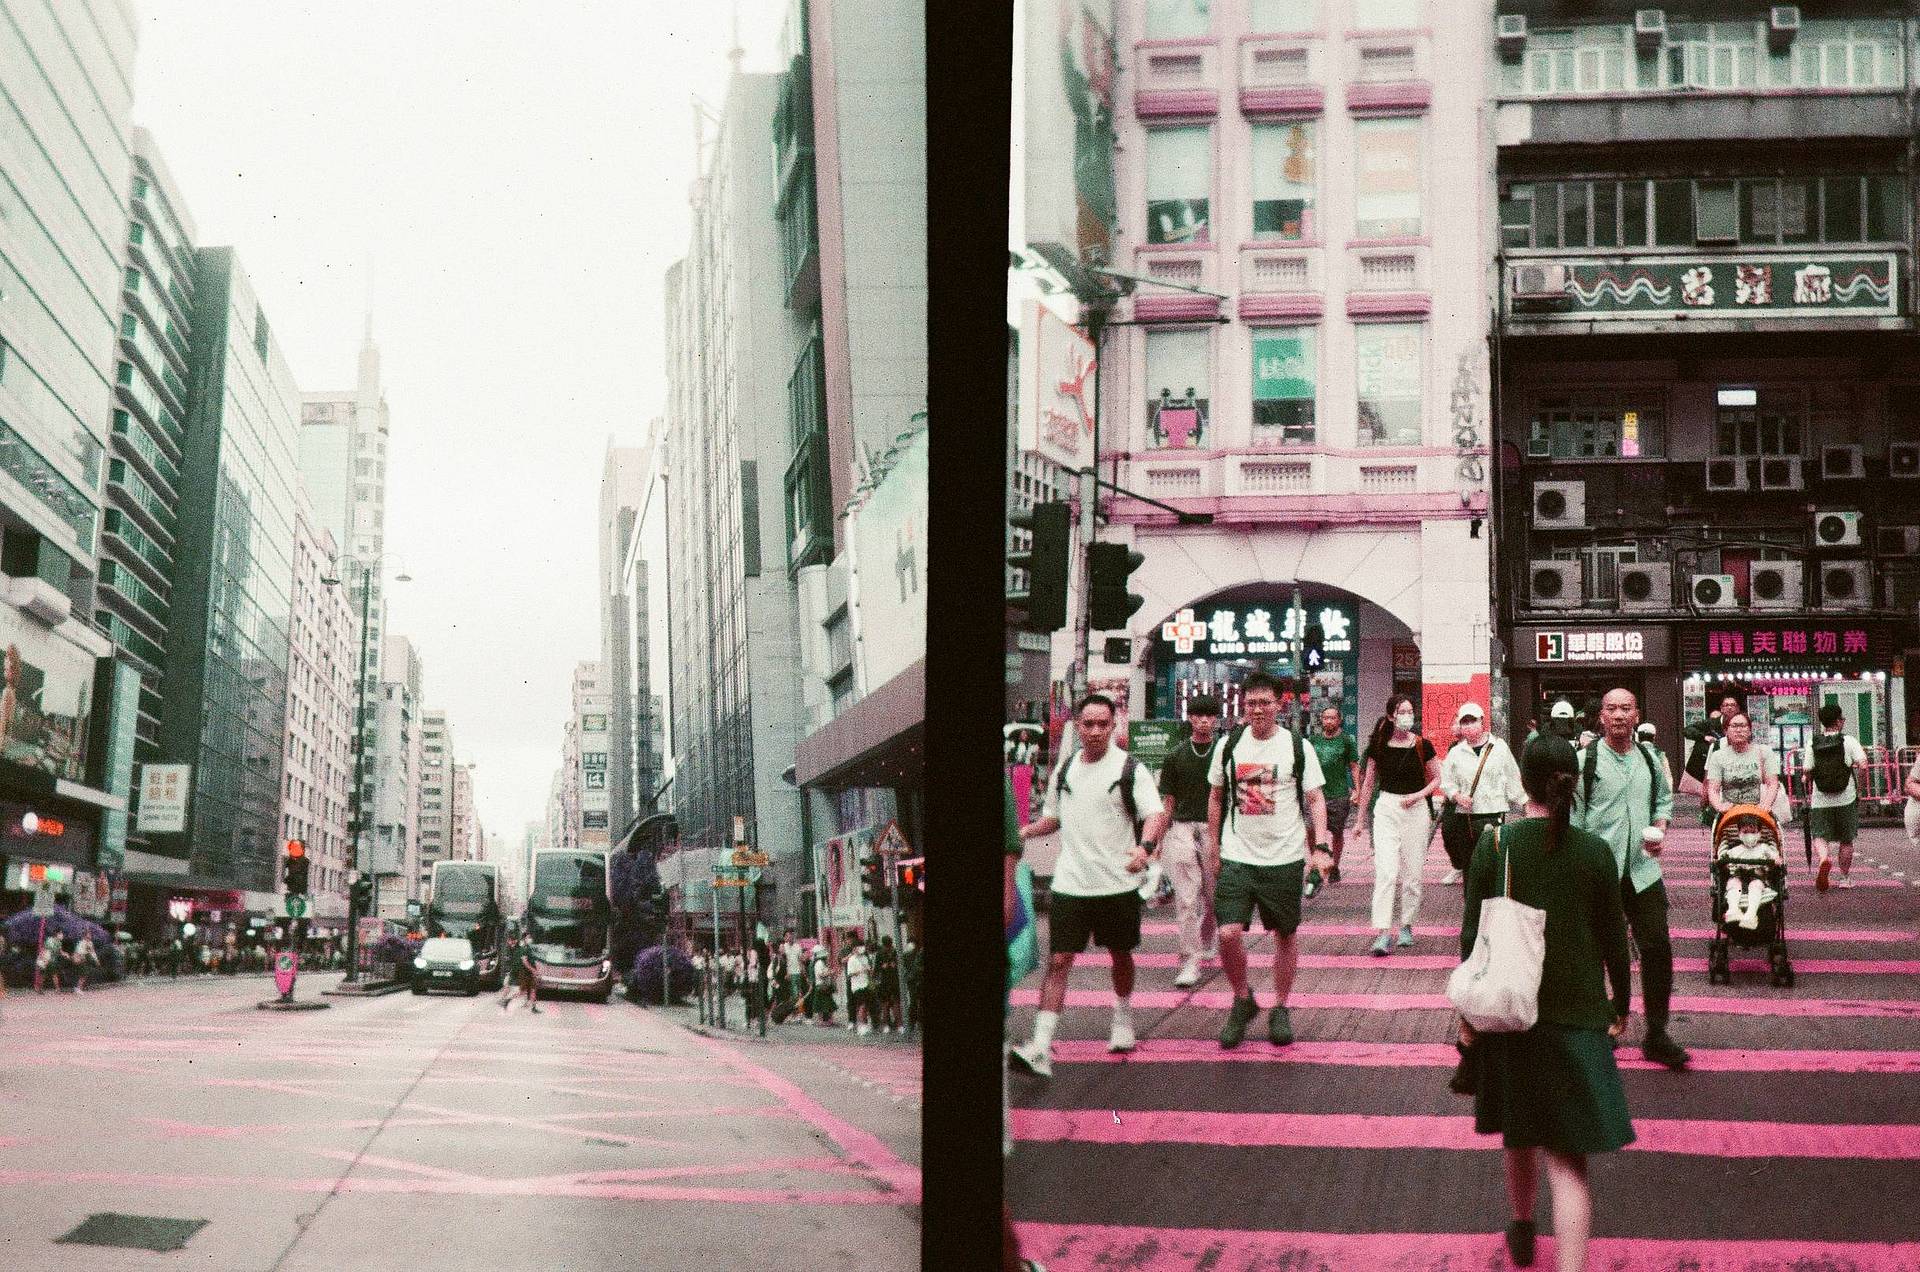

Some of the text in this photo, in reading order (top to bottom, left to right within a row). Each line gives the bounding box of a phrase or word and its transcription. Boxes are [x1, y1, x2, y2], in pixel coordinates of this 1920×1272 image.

[1752, 630, 1868, 654] 美聯物業
[1567, 651, 1644, 662] Huafa Properties
